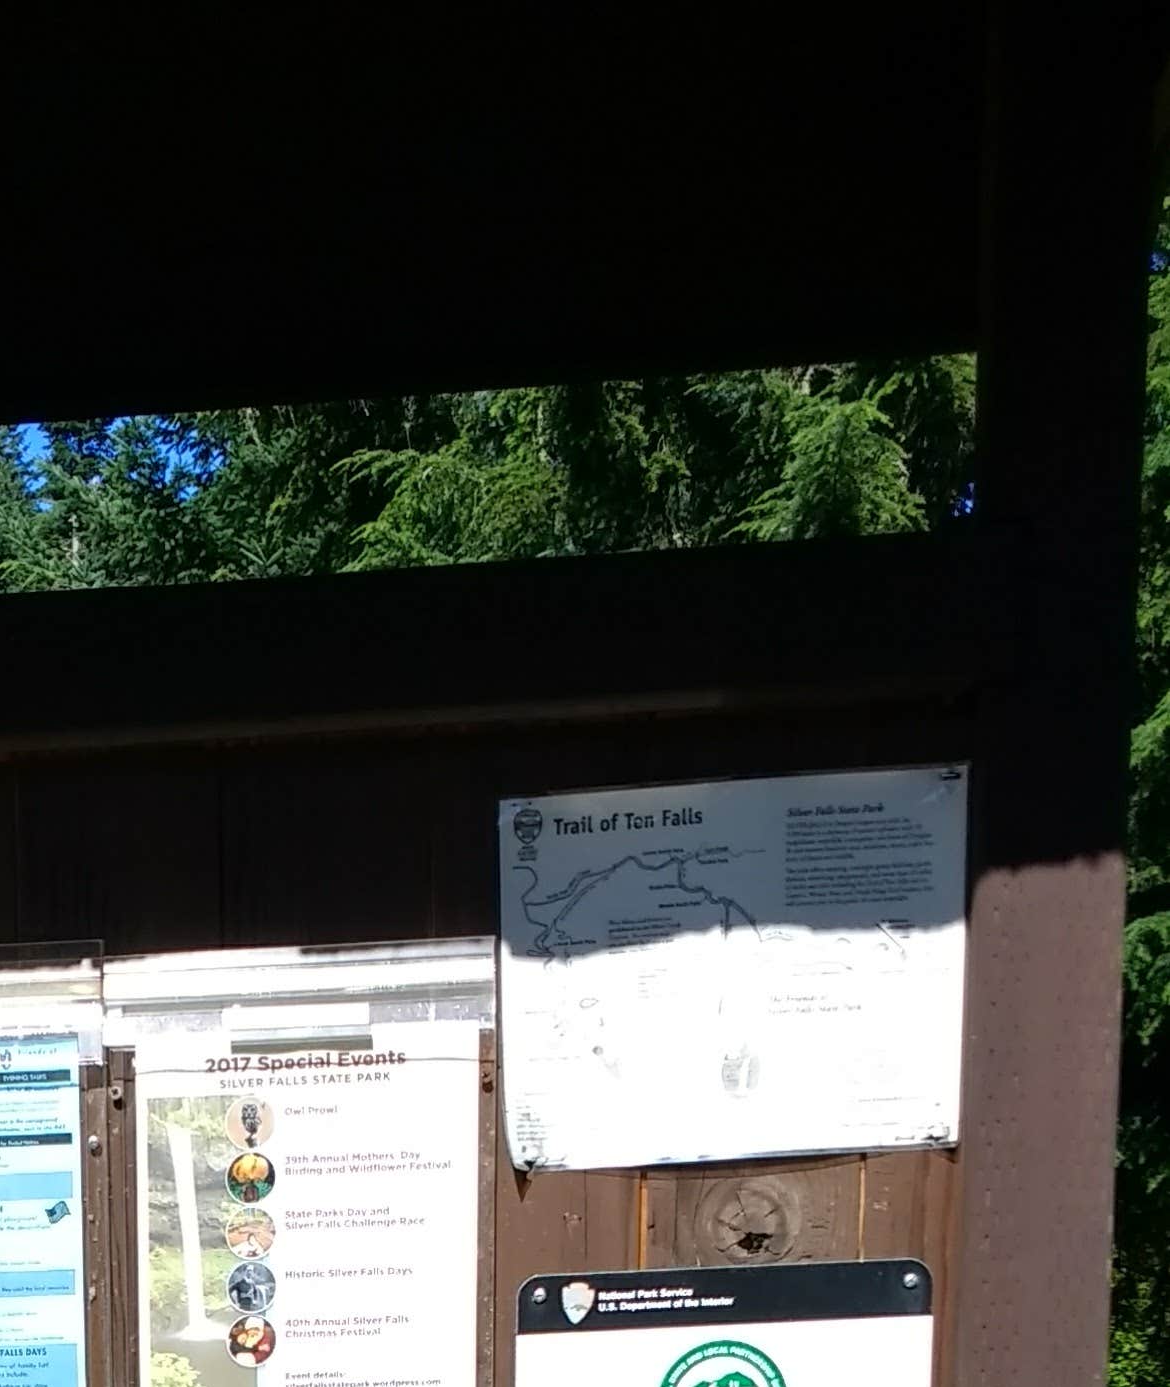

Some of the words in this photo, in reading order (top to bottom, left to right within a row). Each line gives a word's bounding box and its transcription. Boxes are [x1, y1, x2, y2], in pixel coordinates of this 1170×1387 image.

[553, 816, 593, 836] Trail
[600, 812, 620, 832] of
[626, 812, 655, 831] Ten
[661, 808, 703, 828] Falls
[205, 1056, 252, 1074] 2017
[257, 1052, 331, 1075] Special
[337, 1050, 407, 1067] Events
[220, 1077, 264, 1089] SILVER
[269, 1075, 308, 1087] FALLS
[313, 1073, 351, 1084] STATE
[357, 1071, 391, 1082] PARK
[312, 1153, 349, 1164] Annual
[400, 1150, 421, 1162] Day
[285, 1166, 323, 1177] Birding
[326, 1165, 346, 1175] and
[349, 1163, 407, 1174] Wildflower
[409, 1159, 452, 1171] Festival
[285, 1210, 313, 1220] State
[315, 1208, 344, 1219] Parks
[347, 1207, 367, 1219] Day
[370, 1206, 390, 1216] and
[285, 1221, 314, 1231] Silver
[317, 1219, 341, 1229] Falls
[343, 1217, 397, 1229] Challenge
[399, 1216, 426, 1226] Race
[285, 1269, 325, 1280] Historic
[328, 1268, 358, 1278] Silver
[360, 1266, 384, 1277] Falls
[387, 1266, 413, 1277] Days
[598, 1289, 636, 1301] National
[637, 1288, 658, 1299] Park
[660, 1287, 694, 1298] Service
[598, 1302, 617, 1312] U.S.
[619, 1299, 671, 1313] Department
[673, 1298, 684, 1308] of
[685, 1298, 699, 1308] the
[701, 1296, 735, 1307] Interior
[313, 1316, 350, 1327] Annual
[353, 1315, 383, 1326] Silver
[385, 1314, 410, 1324] Falls
[285, 1328, 337, 1339] Christmas
[340, 1326, 381, 1337] Festival
[0, 1348, 24, 1357] FALLS
[25, 1347, 48, 1356] DAYS
